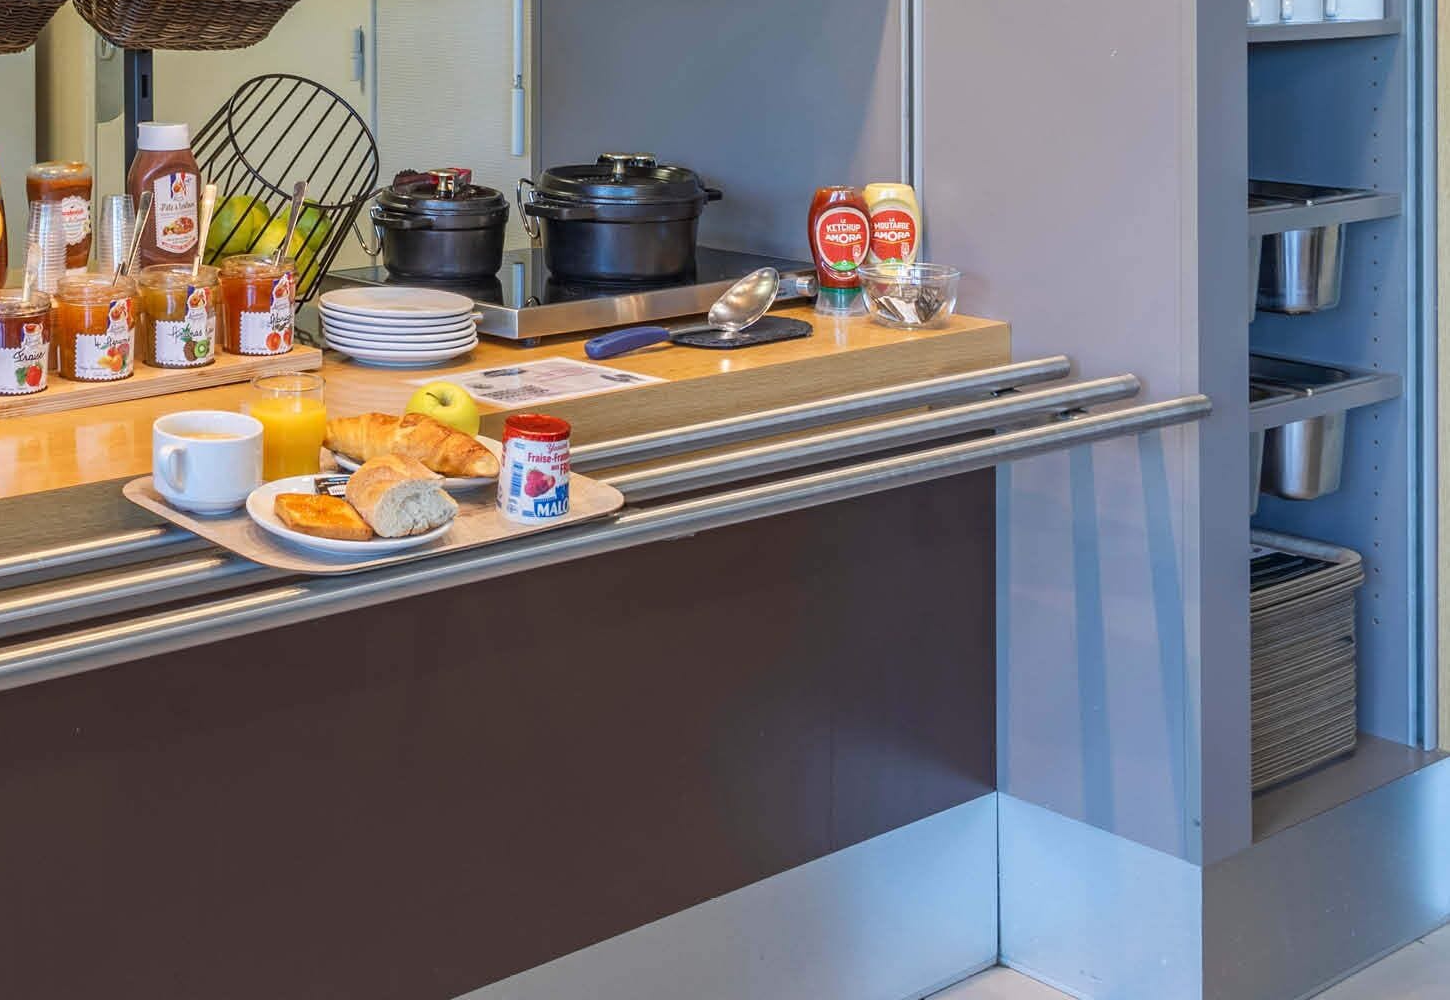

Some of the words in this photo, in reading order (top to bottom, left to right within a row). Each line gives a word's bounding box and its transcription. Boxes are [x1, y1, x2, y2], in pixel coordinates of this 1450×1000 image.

[826, 223, 861, 232] KETCHUP
[874, 222, 910, 230] MOUTARDE
[825, 233, 861, 244] AMORA
[874, 231, 910, 241] AMORA
